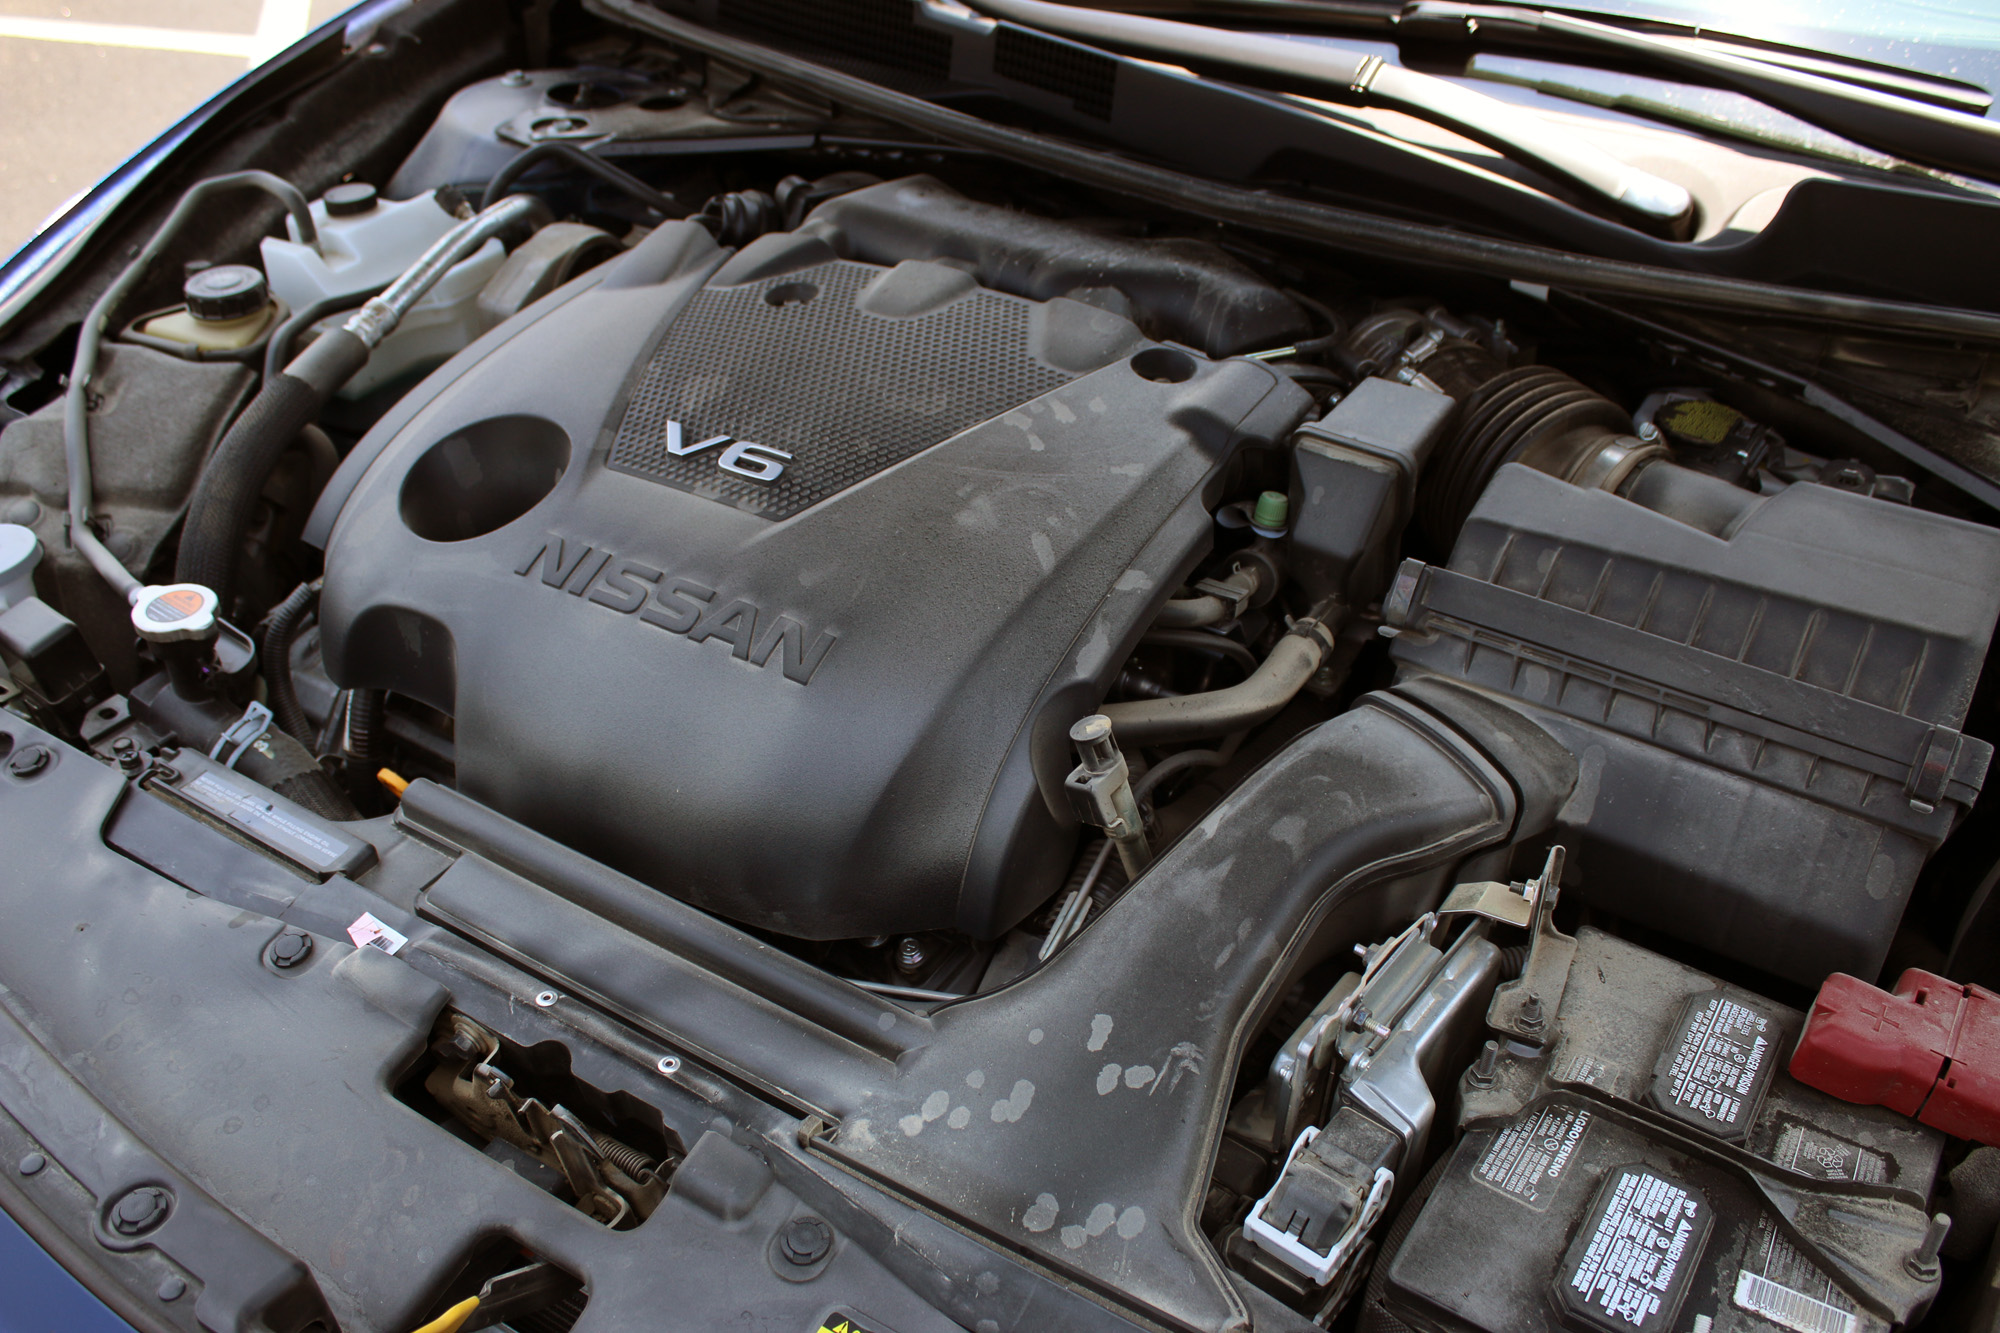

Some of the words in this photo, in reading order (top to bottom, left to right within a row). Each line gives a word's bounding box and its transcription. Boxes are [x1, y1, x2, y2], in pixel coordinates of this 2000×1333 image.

[666, 418, 794, 482] V6
[514, 531, 838, 687] NISSAN
[1735, 1044, 1765, 1095] DANGER/POISON
[1547, 1110, 1590, 1178] LIGRO/VENENO
[1650, 1229, 1689, 1292] DANGER/POISON
